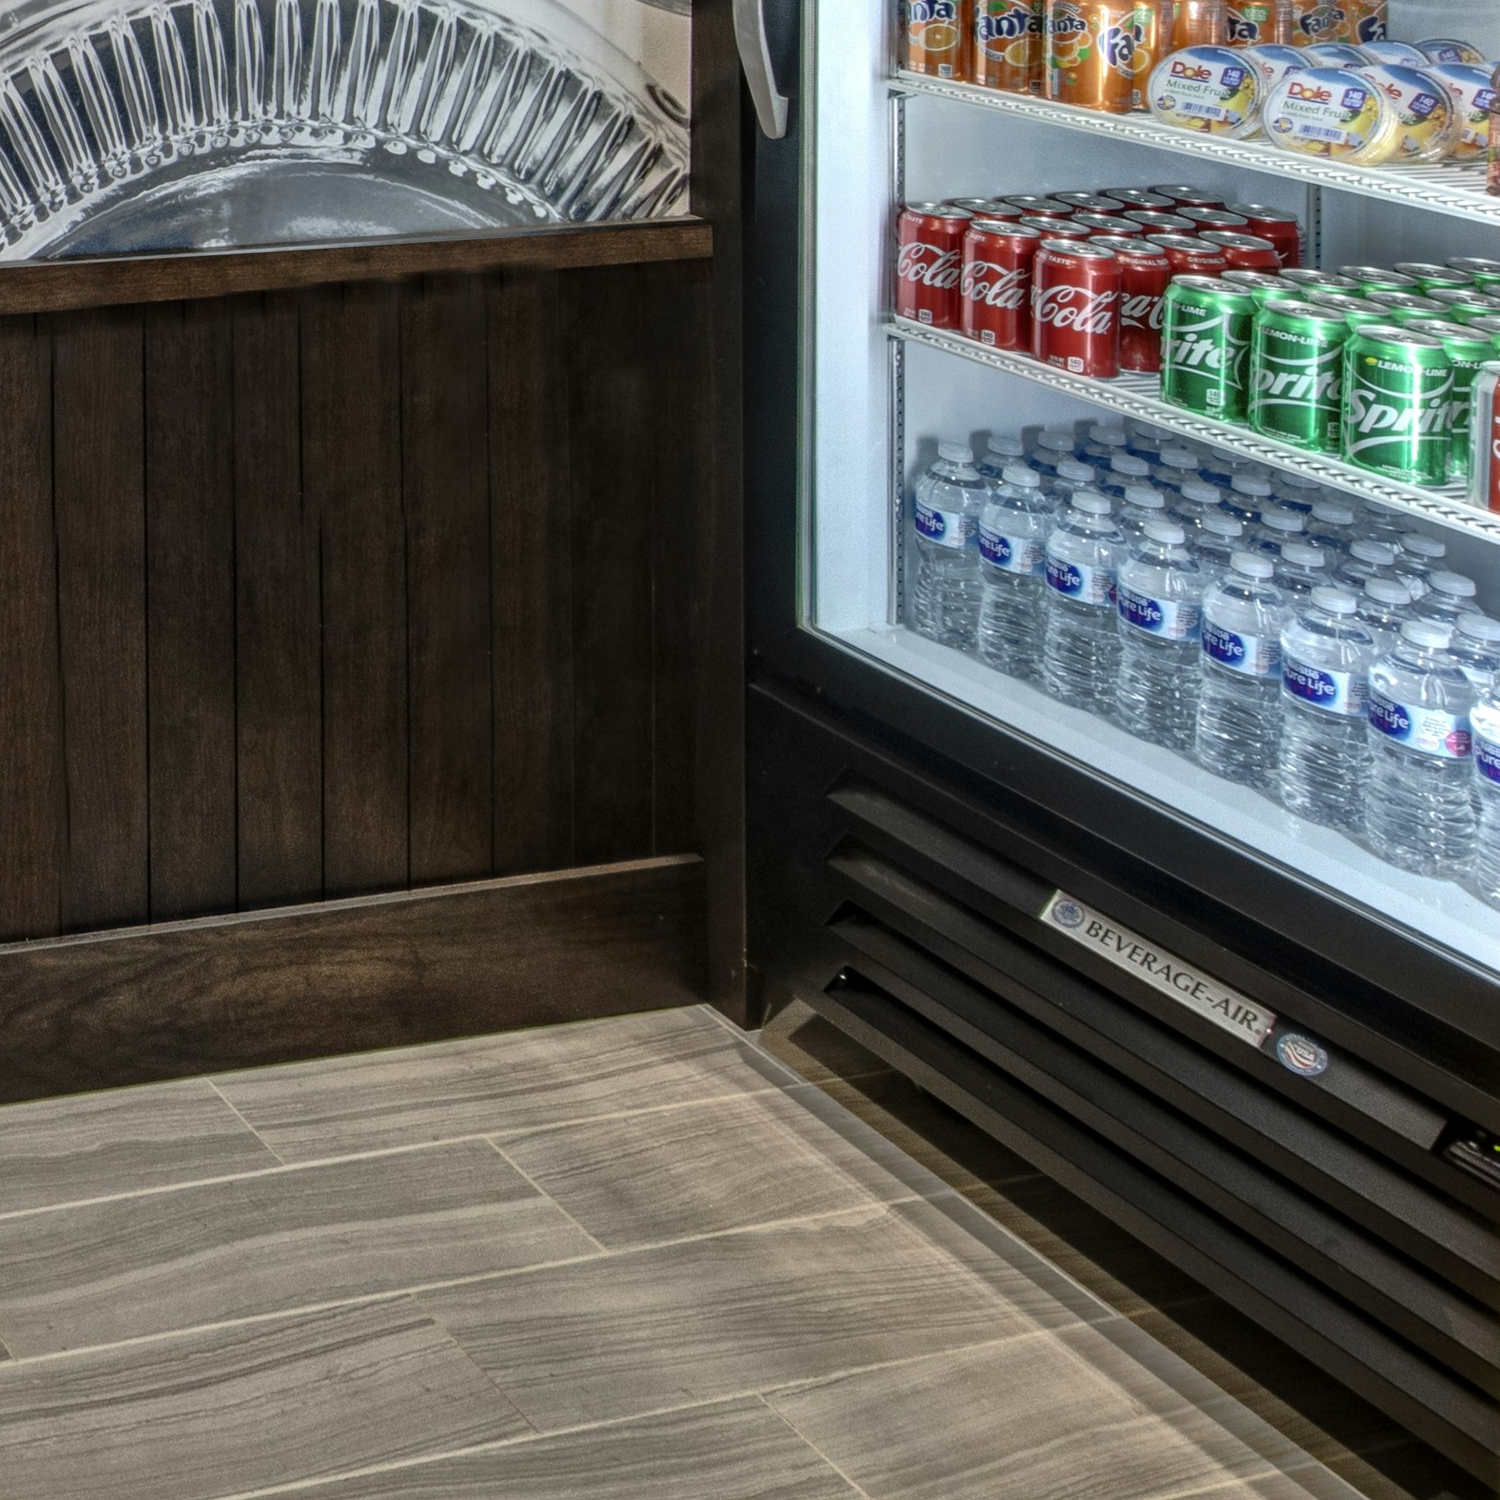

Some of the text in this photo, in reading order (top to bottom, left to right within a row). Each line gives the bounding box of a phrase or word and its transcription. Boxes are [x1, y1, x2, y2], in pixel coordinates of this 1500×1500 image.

[1170, 60, 1213, 80] Dole
[1165, 79, 1232, 100] Mixed Fruit
[1288, 81, 1332, 102] Dole
[1283, 100, 1351, 122] Mixed Fruit
[1034, 285, 1120, 335] Cola
[925, 515, 945, 533] Life
[992, 539, 1011, 558] Life
[1060, 568, 1082, 588] Life
[1137, 603, 1161, 623] Life
[1219, 638, 1243, 658] Life
[1307, 676, 1335, 697] Life
[1385, 709, 1410, 731] Life
[1085, 919, 1260, 1033] BEVERAGE-AIR
